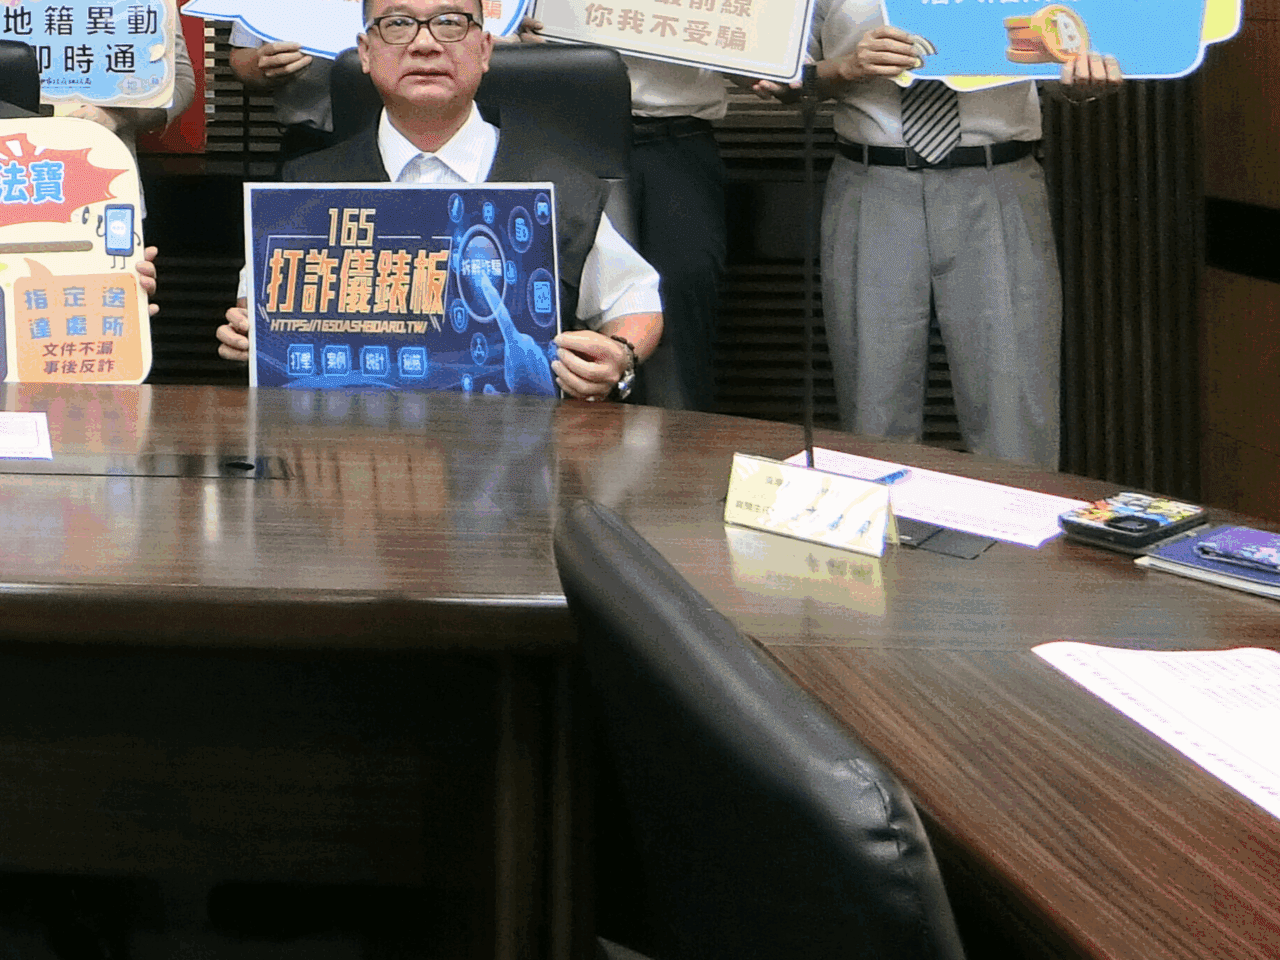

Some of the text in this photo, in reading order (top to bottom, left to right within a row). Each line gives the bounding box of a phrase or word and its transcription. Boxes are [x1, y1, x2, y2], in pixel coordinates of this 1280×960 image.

[3, 5, 158, 36] 地籍異動
[584, 2, 747, 52] 你我不受騙
[327, 207, 377, 247] 165
[42, 340, 114, 357] 文件不漏
[43, 358, 115, 375] 事後反詐
